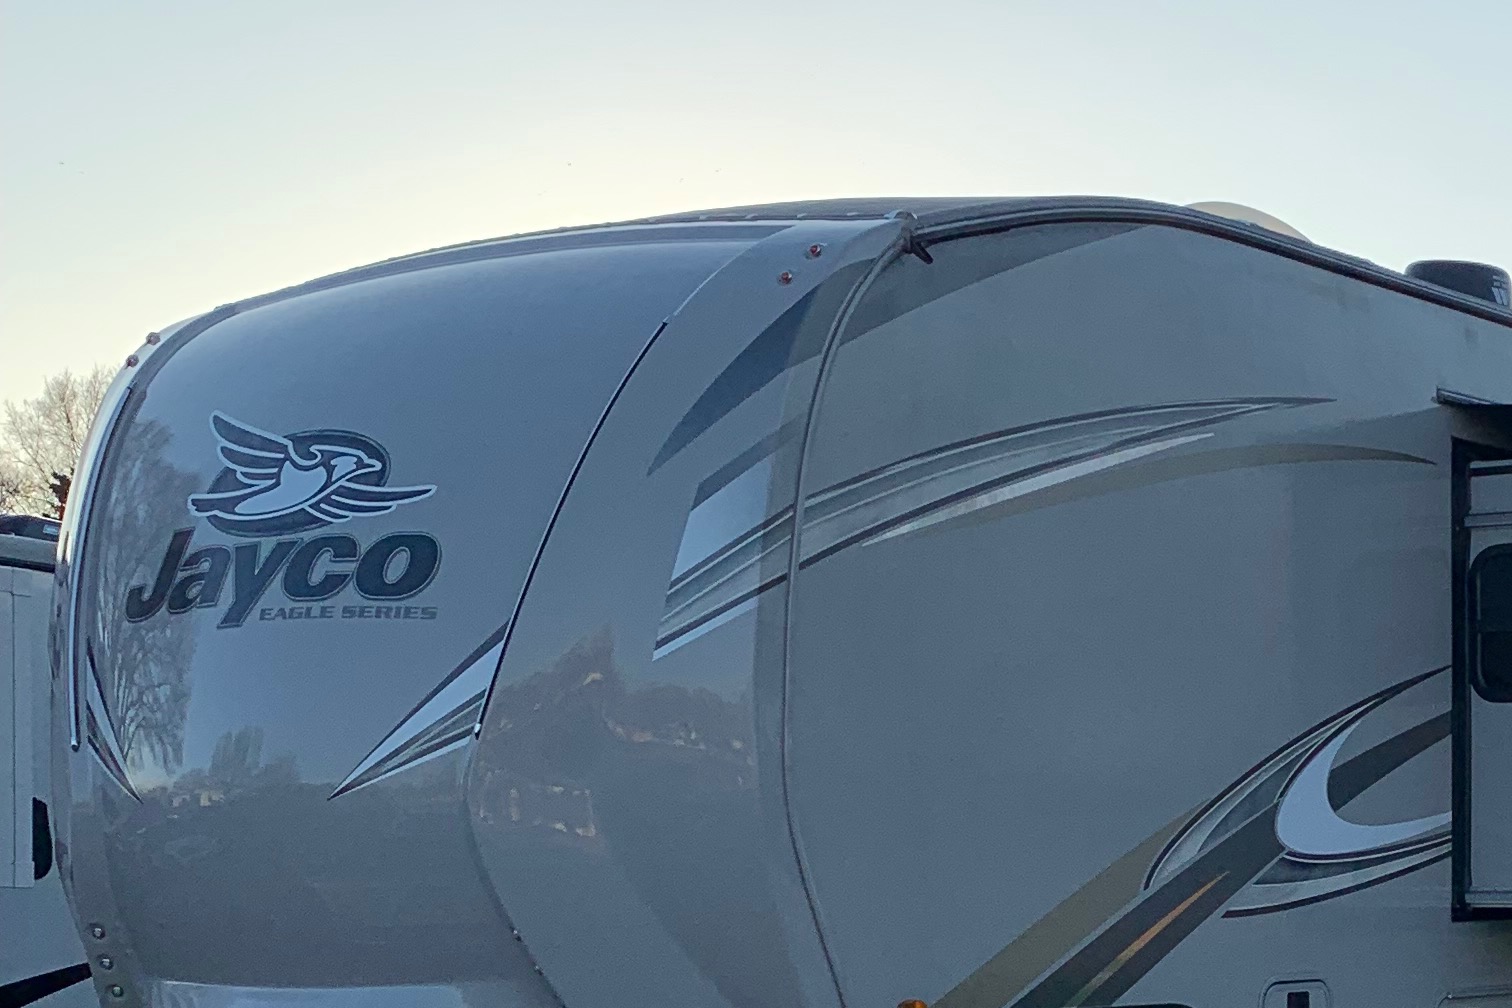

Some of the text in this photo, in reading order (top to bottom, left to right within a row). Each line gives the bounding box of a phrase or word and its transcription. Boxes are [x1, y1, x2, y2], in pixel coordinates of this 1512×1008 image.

[125, 526, 442, 629] Jayco
[258, 606, 439, 621] EAGLE SERIES
